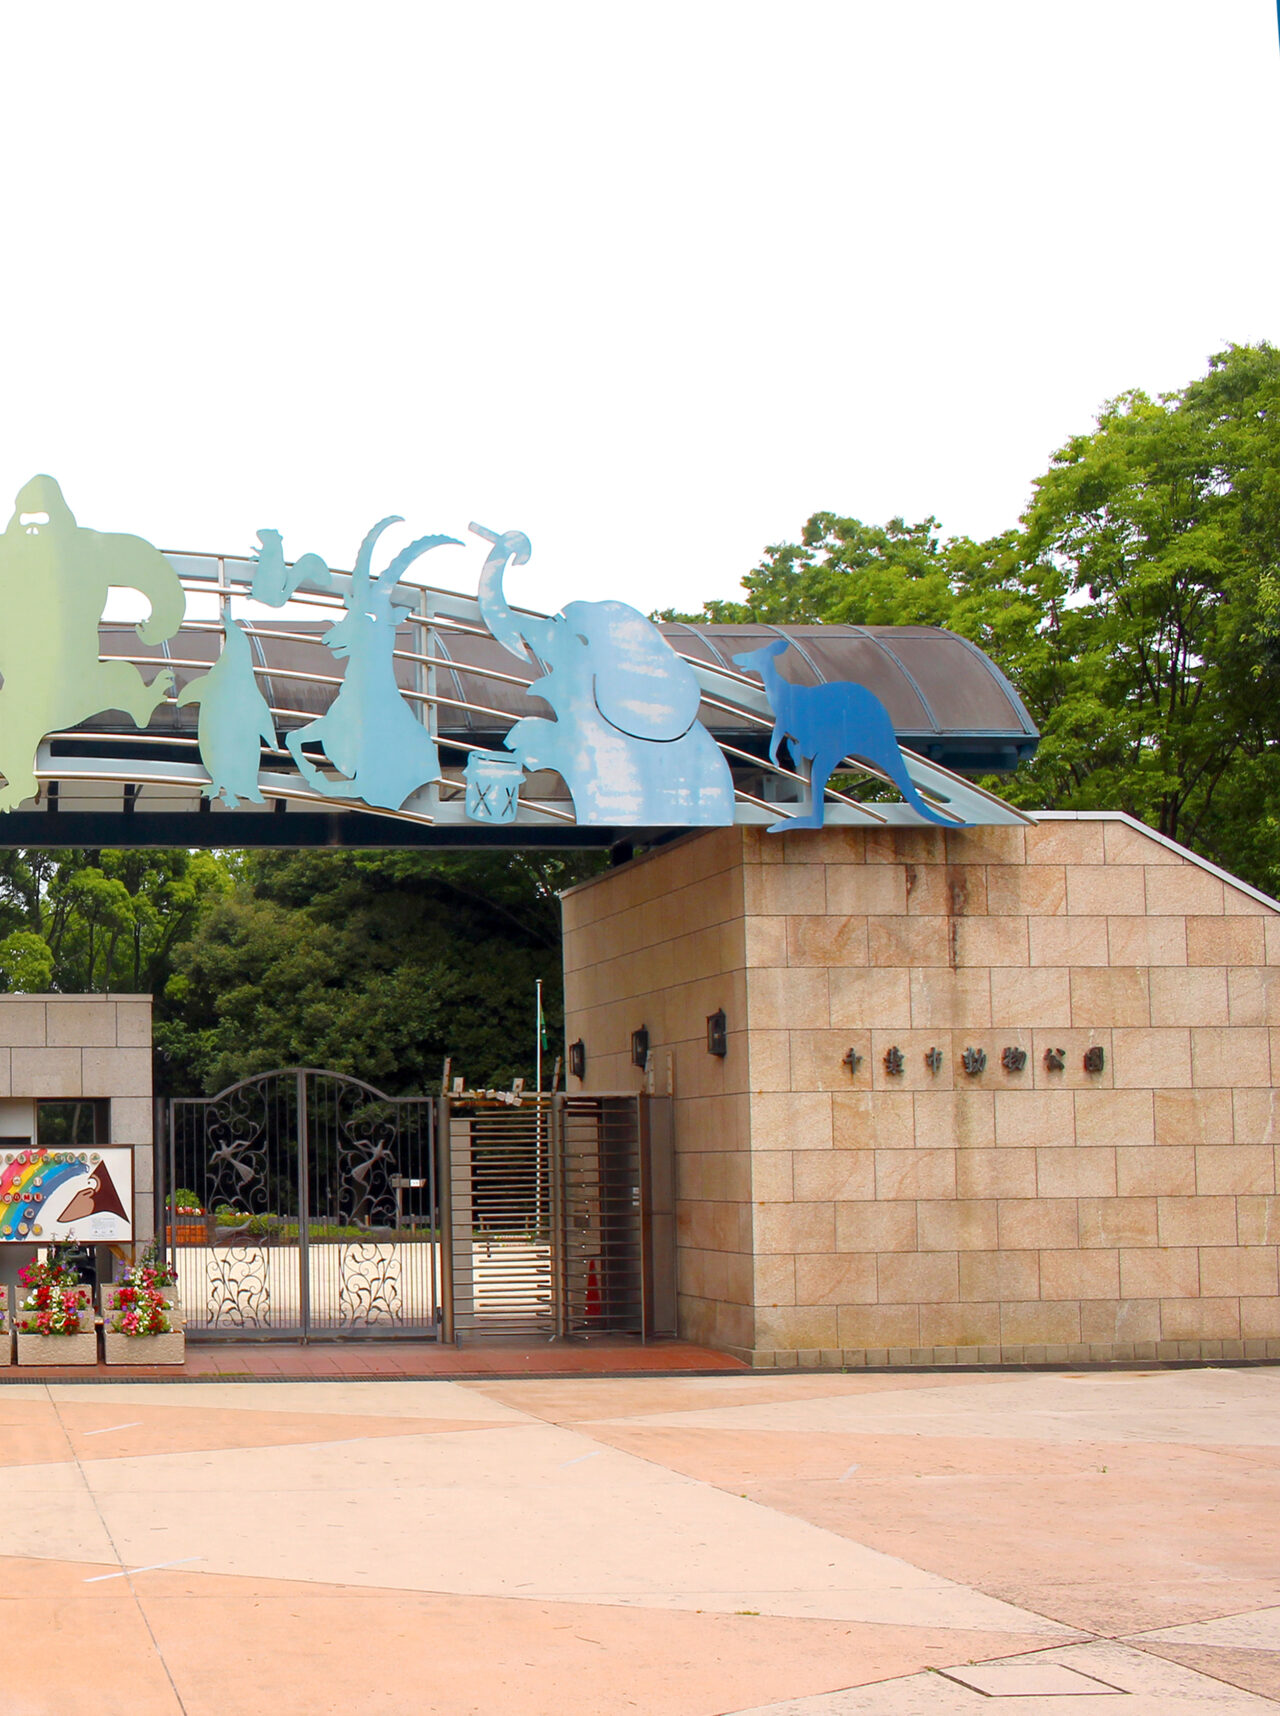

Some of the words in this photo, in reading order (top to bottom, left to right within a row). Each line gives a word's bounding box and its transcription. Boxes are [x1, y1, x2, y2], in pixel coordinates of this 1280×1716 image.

[842, 1046, 1105, 1076] 千葉市動物公園
